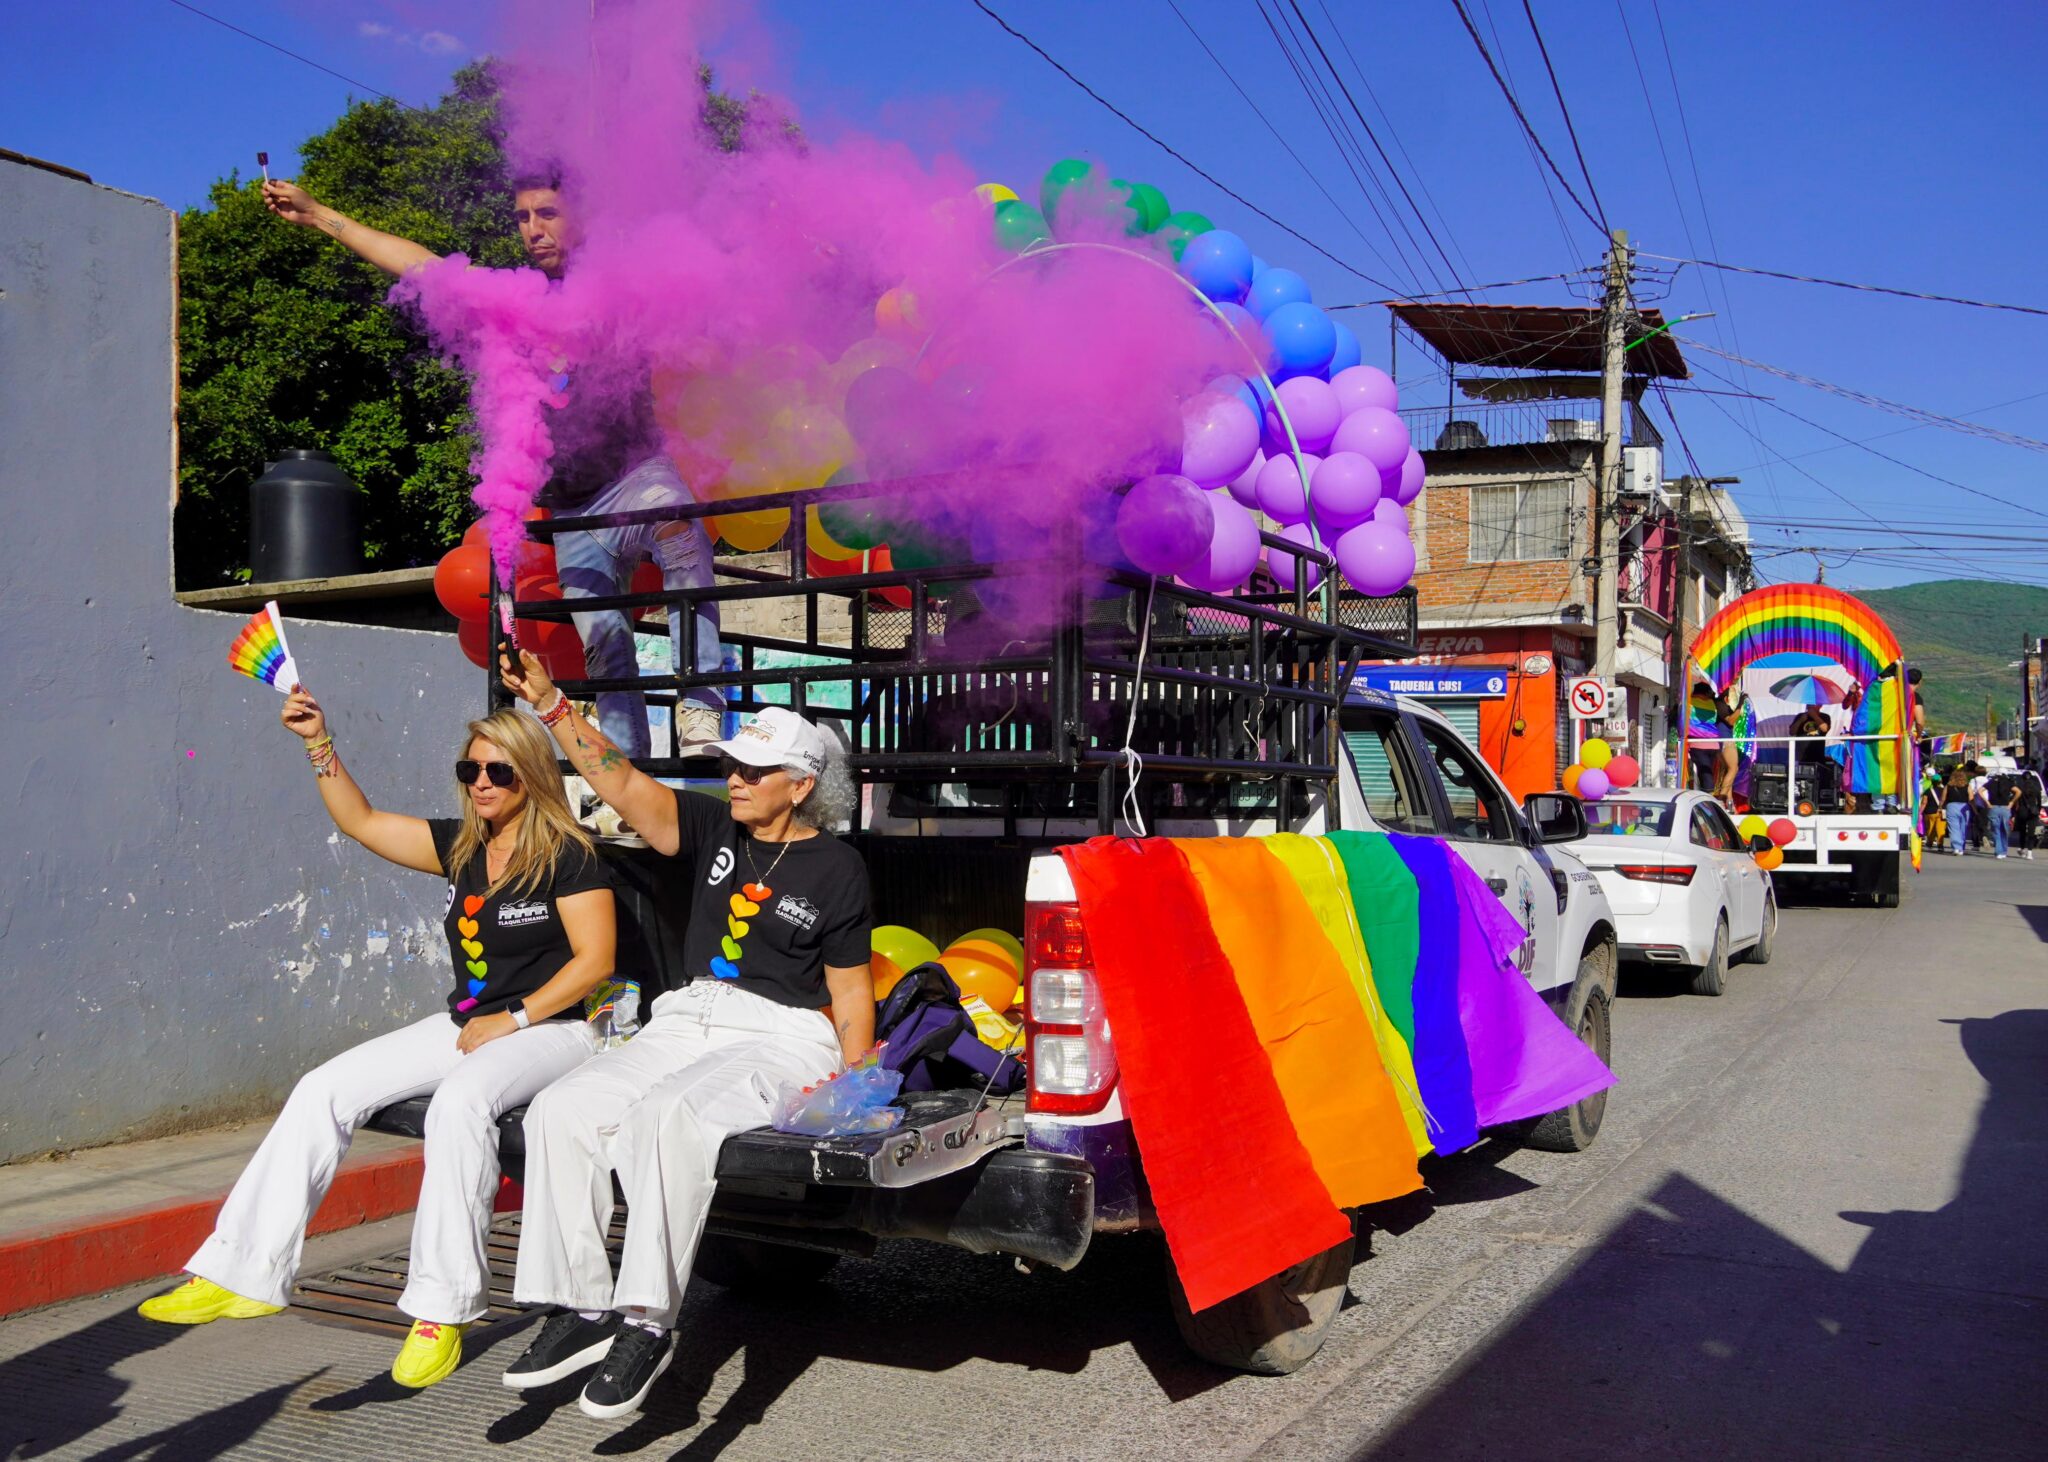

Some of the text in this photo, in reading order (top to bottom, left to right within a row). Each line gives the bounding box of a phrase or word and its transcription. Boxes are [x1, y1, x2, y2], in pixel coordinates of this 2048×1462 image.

[1419, 636, 1484, 652] ERIA
[1389, 680, 1462, 692] TAQUERIA CUSI
[1517, 938, 1536, 971] DIF
